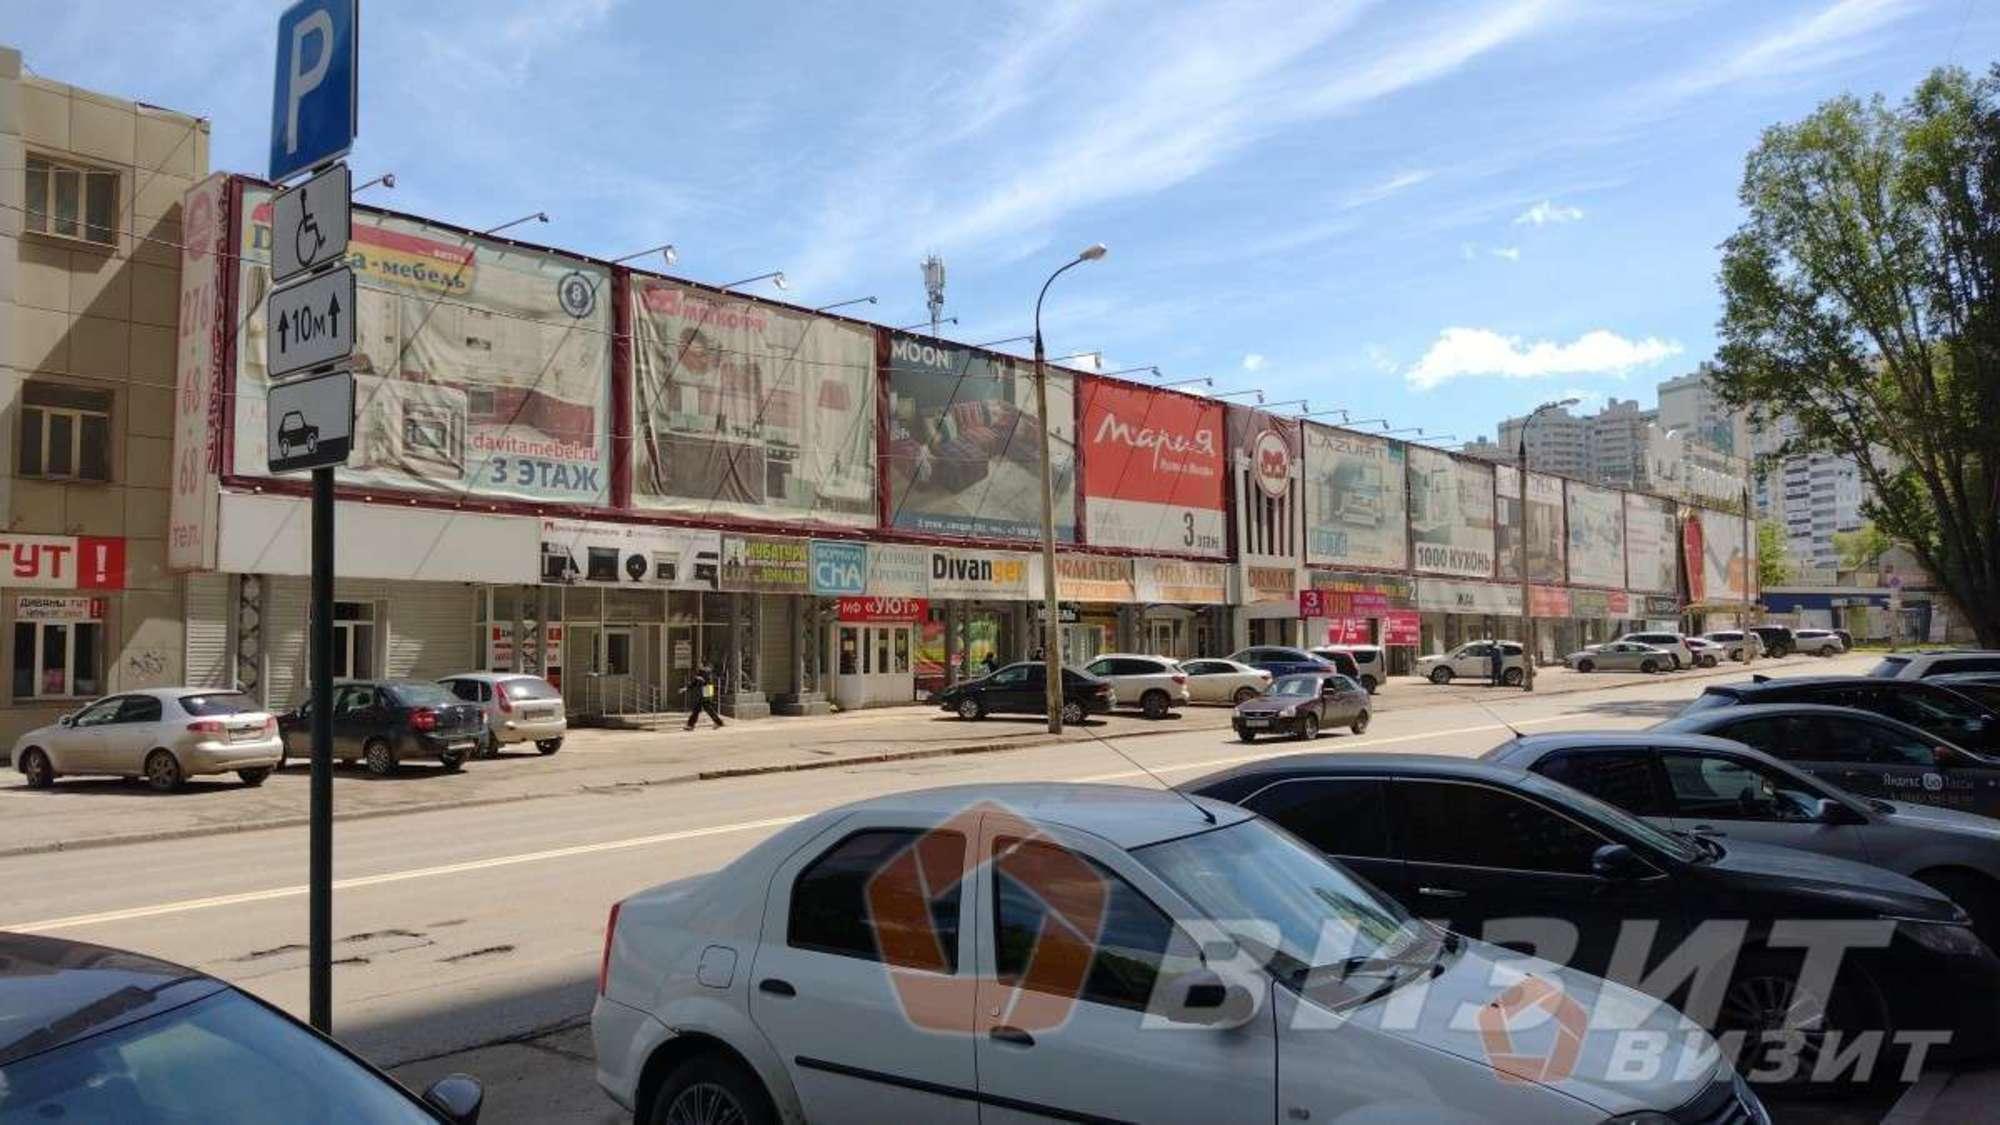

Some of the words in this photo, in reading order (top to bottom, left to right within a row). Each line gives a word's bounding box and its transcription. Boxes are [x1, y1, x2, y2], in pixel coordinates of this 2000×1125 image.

[891, 339, 950, 369] MOON
[472, 431, 599, 461] davitamebel.ru
[1094, 413, 1216, 472] Мария
[490, 457, 508, 484] 3
[517, 460, 599, 492] ЭТАЖ
[1184, 511, 1195, 547] 3
[932, 553, 1024, 588] Divanger
[1418, 545, 1448, 569] 1000
[1450, 548, 1491, 572] КУХОНЬ
